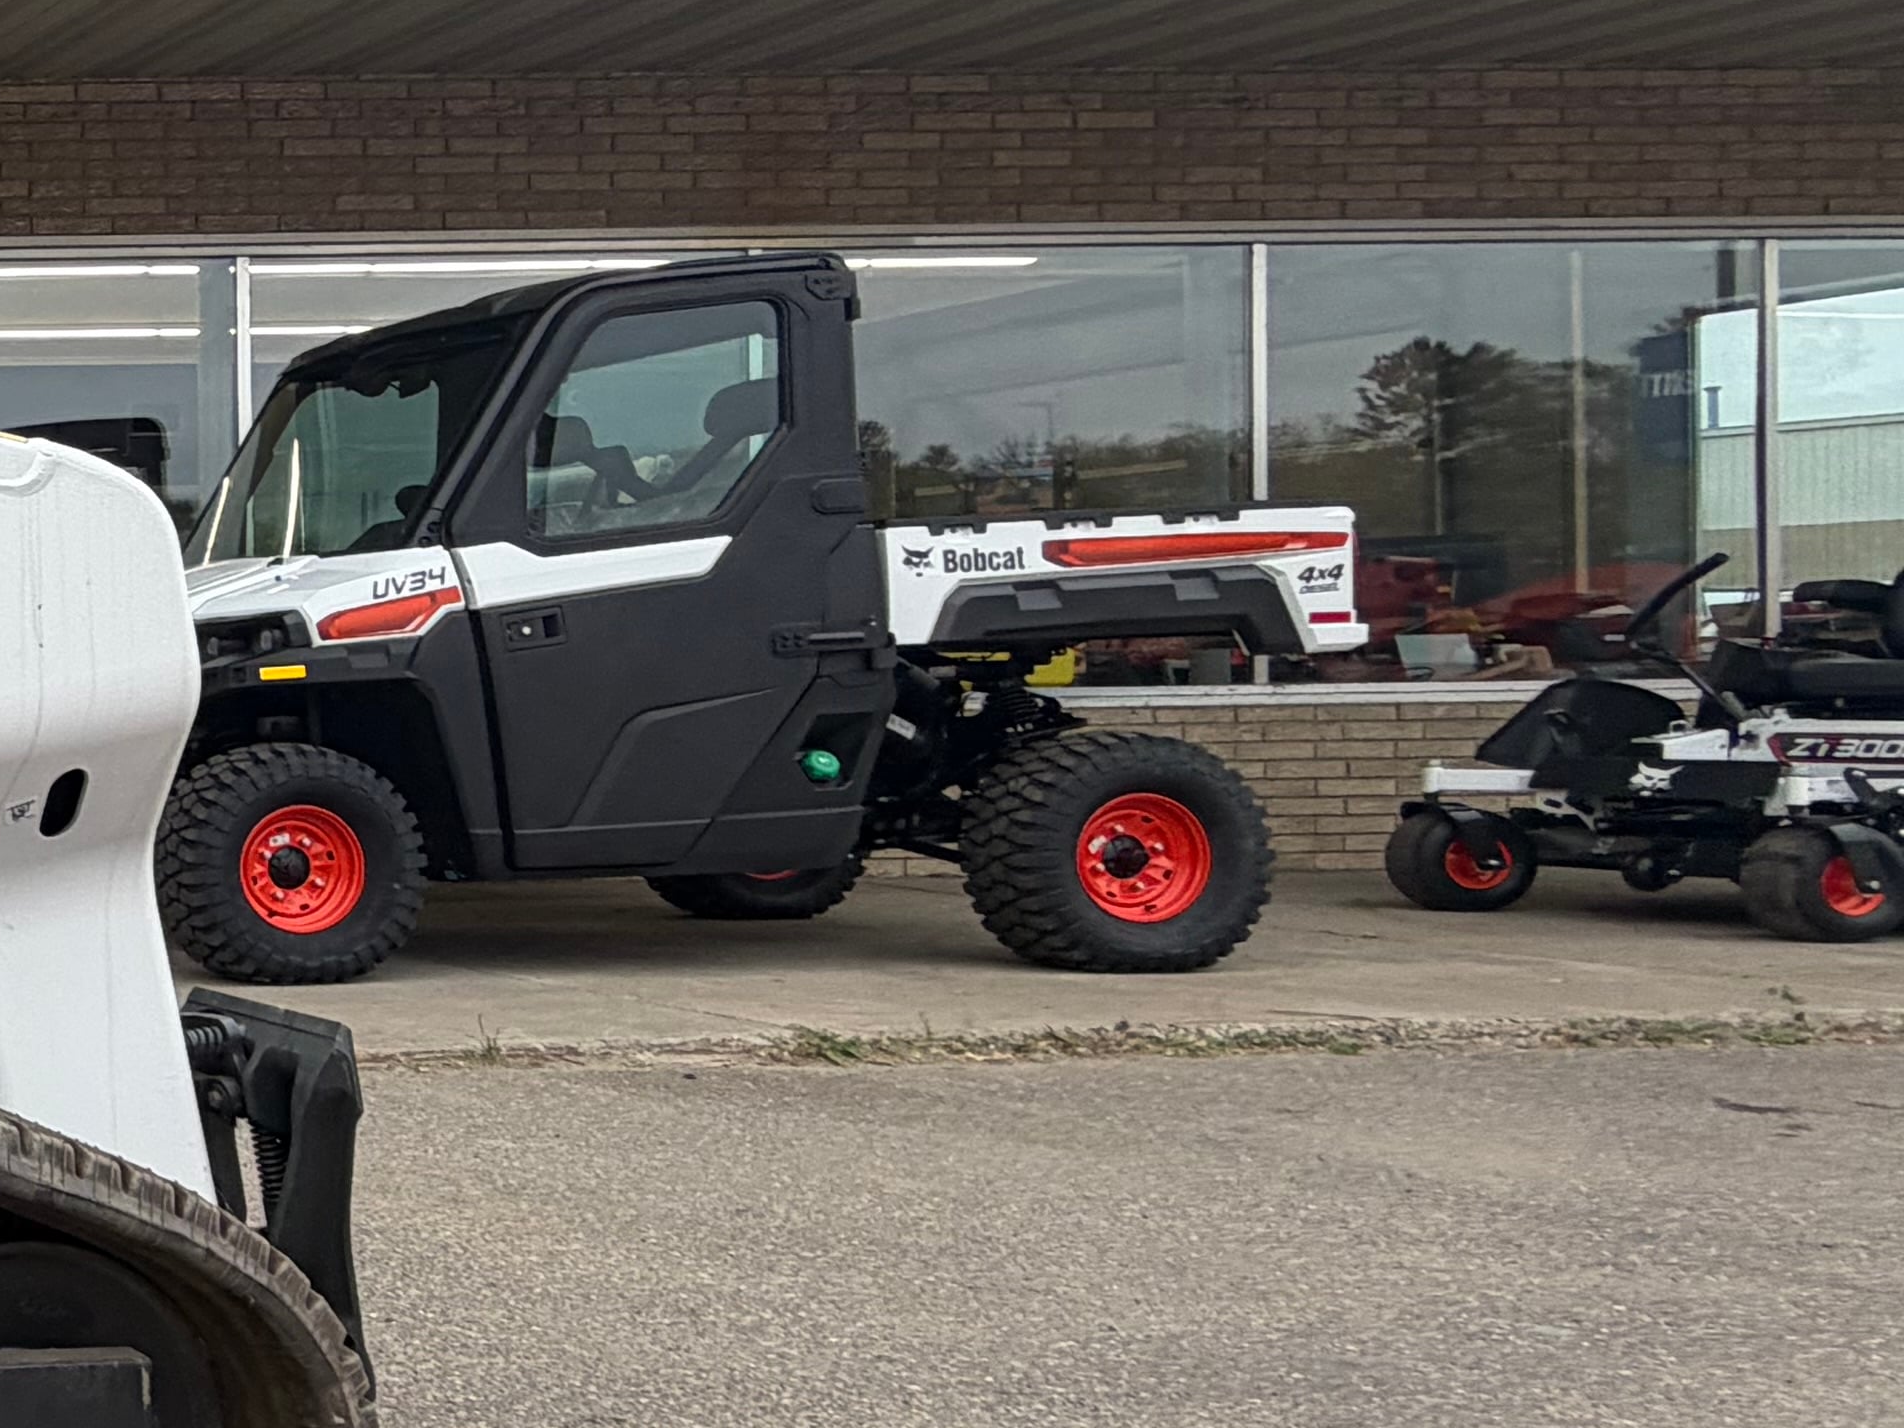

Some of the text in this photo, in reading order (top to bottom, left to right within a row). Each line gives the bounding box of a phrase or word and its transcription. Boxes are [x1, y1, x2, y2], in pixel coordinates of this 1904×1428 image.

[942, 546, 1026, 574] Bobcat
[372, 566, 446, 600] UV34
[1297, 563, 1345, 584] 4x4
[1786, 737, 1904, 759] ZT300
